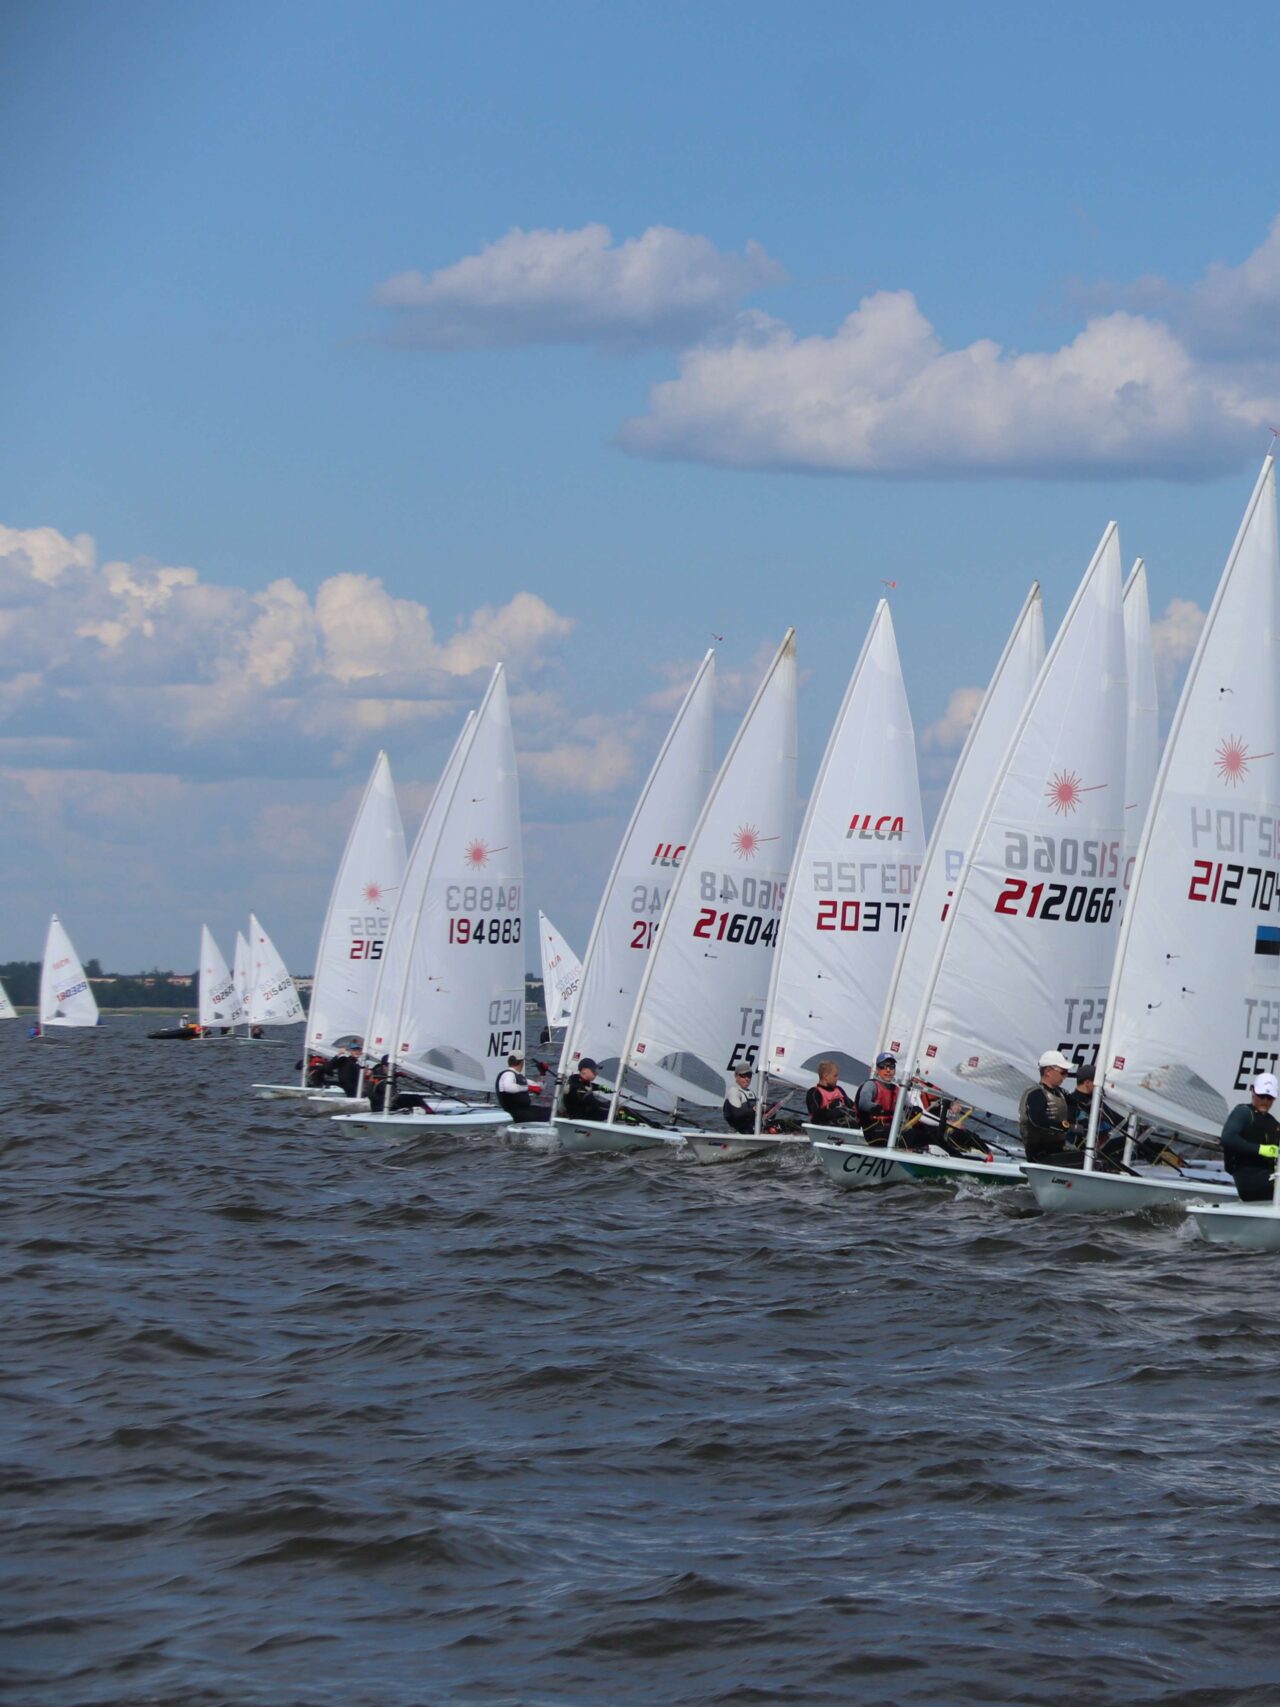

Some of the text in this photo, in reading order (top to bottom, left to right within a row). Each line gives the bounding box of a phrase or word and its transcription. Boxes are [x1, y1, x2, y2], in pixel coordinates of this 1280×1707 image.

[846, 814, 904, 841] ILCA
[651, 843, 687, 868] ILC
[994, 878, 1116, 923] 212066
[817, 900, 911, 932] 2037
[449, 917, 521, 944] 194883
[350, 940, 384, 960] 215
[487, 1030, 522, 1058] NED
[726, 1043, 760, 1074] ES
[842, 1153, 895, 1178] CHN
